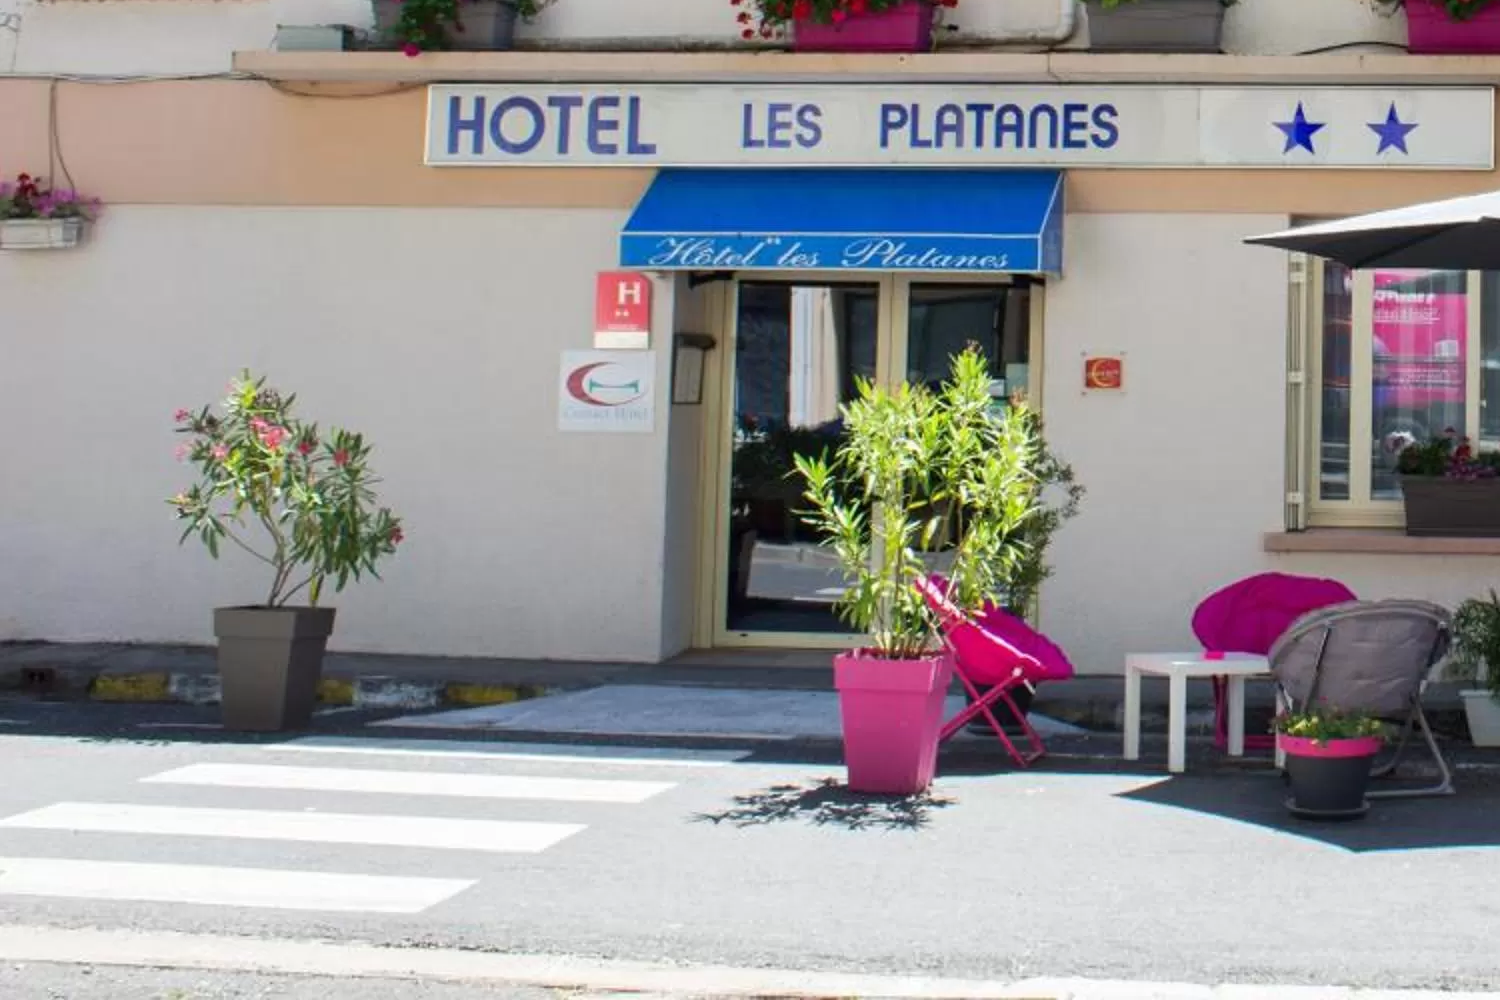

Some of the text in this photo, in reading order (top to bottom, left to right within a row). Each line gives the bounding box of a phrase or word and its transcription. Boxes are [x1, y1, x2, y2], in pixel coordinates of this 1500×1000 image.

[446, 95, 1120, 155] HOTEL LES PLATANES
[649, 236, 1009, 268] Hôtel les Platanes
[617, 281, 641, 304] H
